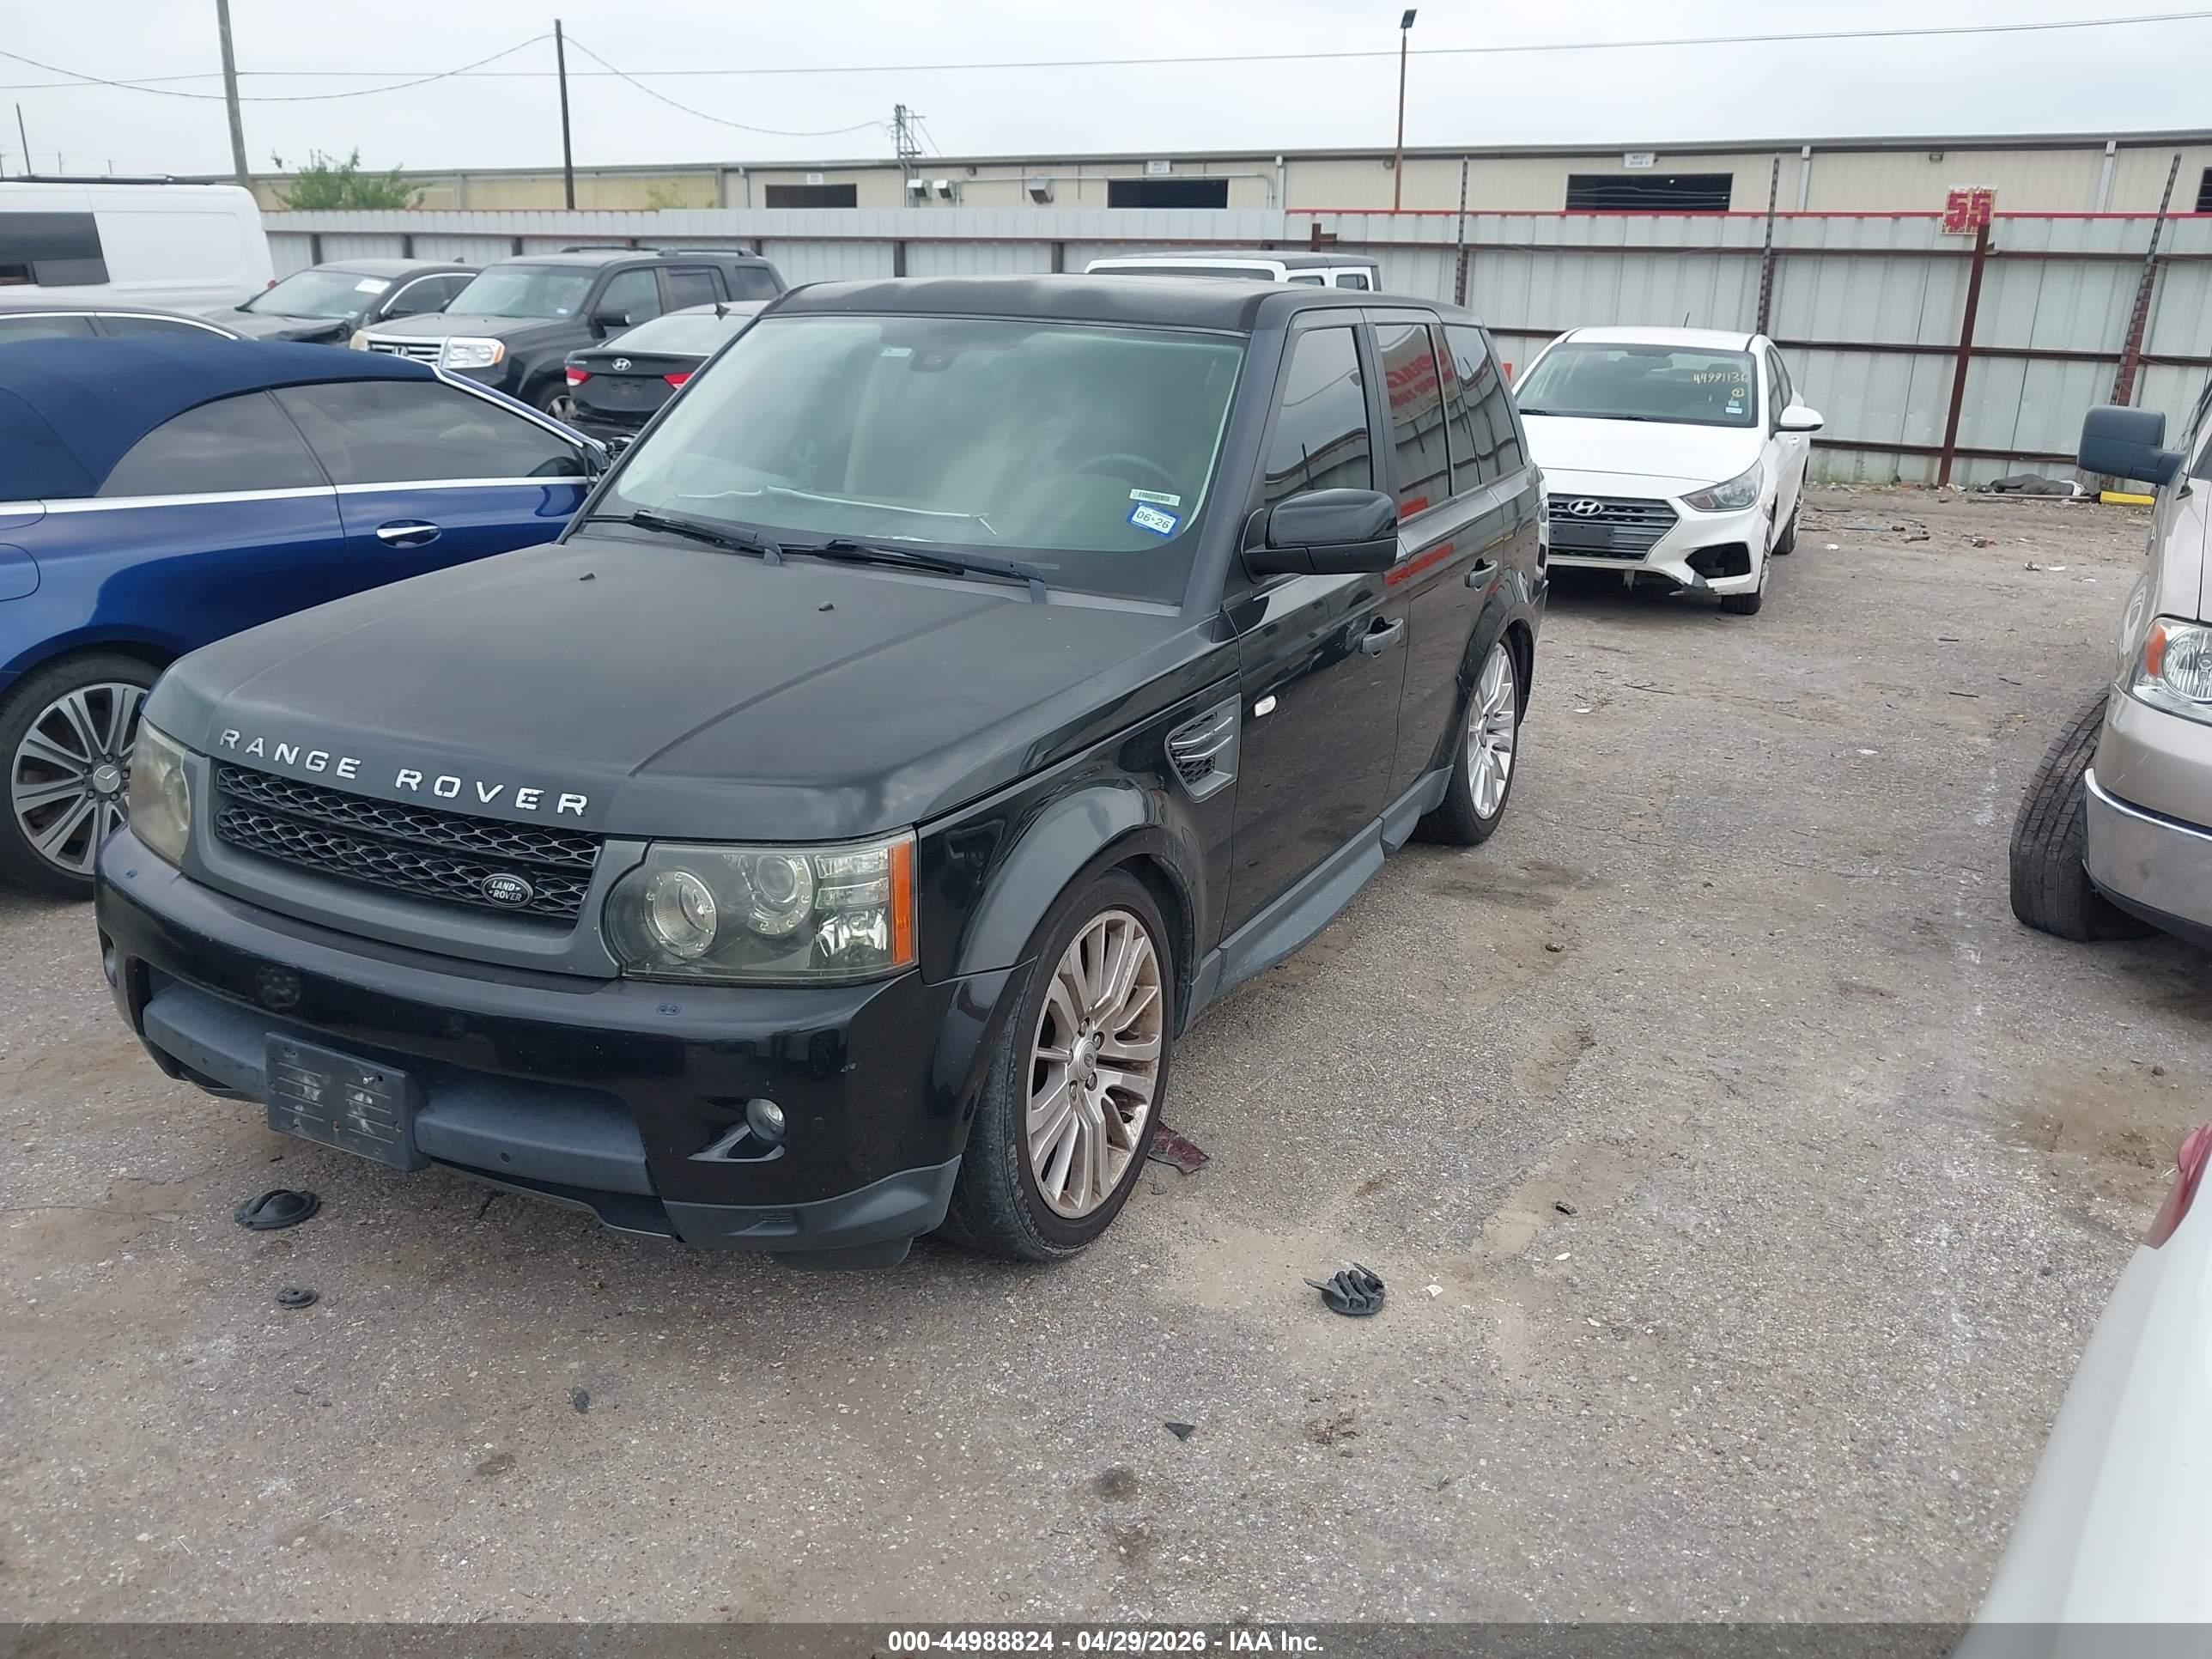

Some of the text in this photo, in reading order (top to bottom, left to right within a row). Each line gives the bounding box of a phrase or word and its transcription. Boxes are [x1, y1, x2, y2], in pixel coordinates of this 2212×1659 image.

[1946, 192, 1992, 230] 55
[219, 728, 589, 817] RANGE ROVER
